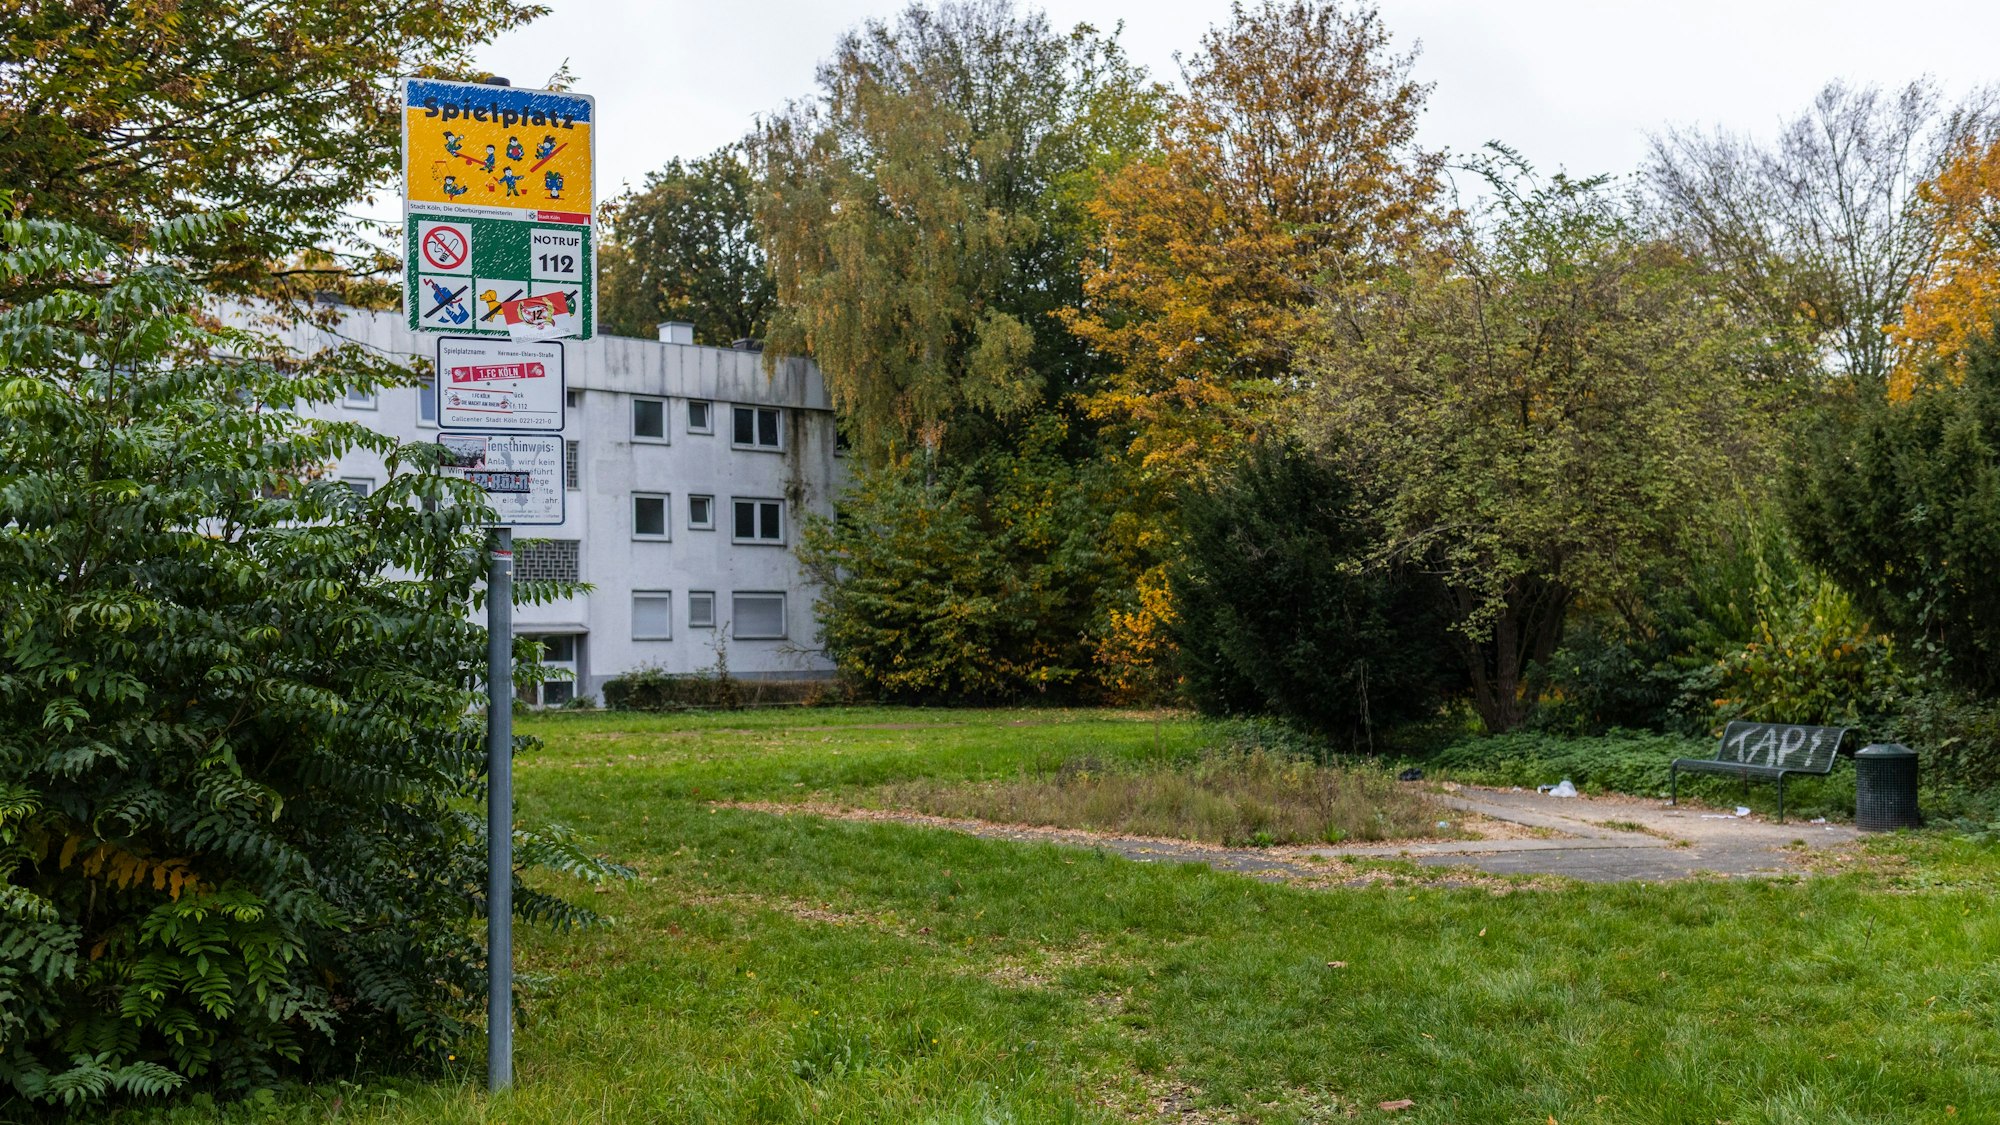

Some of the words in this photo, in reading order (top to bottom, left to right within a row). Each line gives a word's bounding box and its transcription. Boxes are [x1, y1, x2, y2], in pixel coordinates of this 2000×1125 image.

[424, 97, 574, 129] Spielplatz
[410, 203, 426, 211] Stadt
[427, 204, 442, 212] Köln,
[454, 206, 513, 216] Oberbürgermeisterin
[534, 235, 579, 247] NOTRUF
[539, 253, 574, 273] 112
[533, 310, 543, 320] 12
[498, 350, 554, 358] Hermann-Ehlers-Straße
[480, 369, 497, 378] 1.FC
[498, 367, 518, 377] KÖLN
[539, 458, 555, 466] kein
